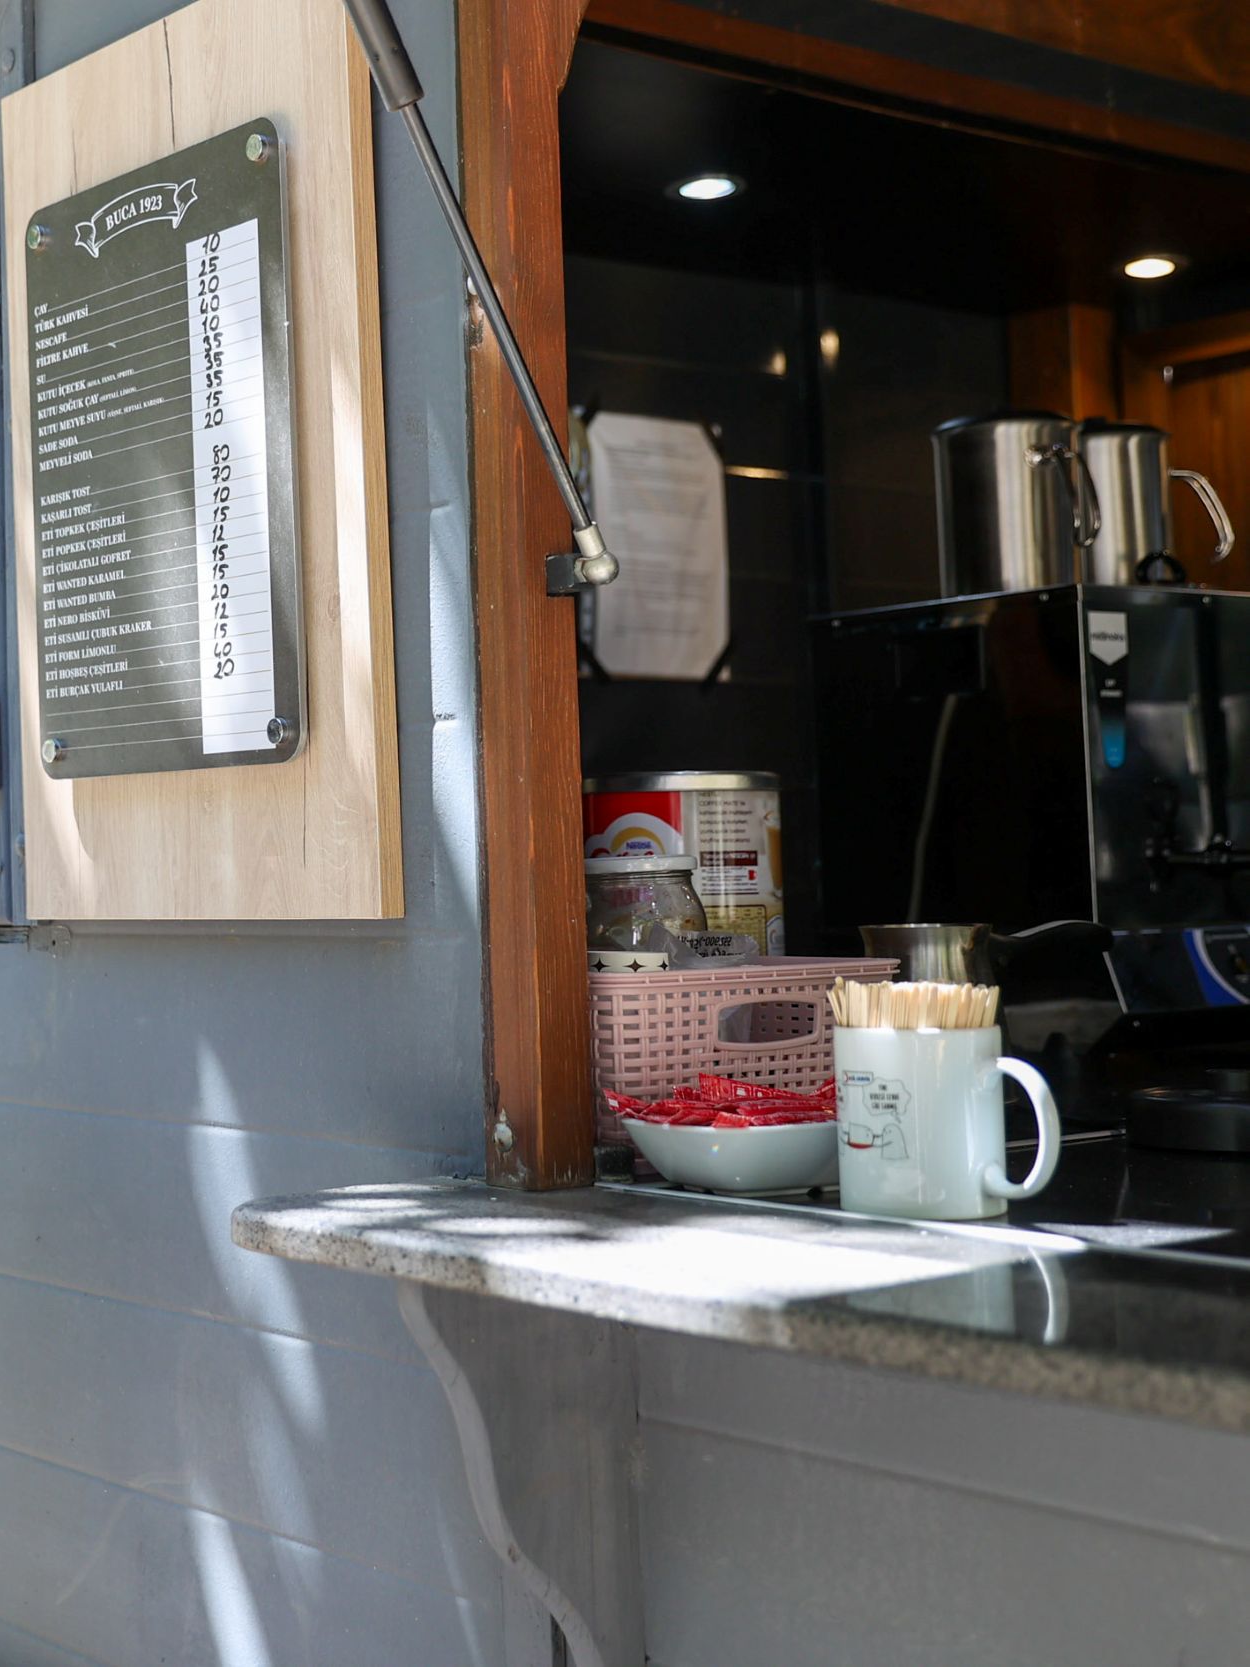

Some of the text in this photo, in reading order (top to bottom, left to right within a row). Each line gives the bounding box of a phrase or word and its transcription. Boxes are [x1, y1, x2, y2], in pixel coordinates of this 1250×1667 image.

[105, 195, 163, 231] BUCA 1923
[202, 232, 220, 253] 10
[198, 255, 220, 277] 25
[198, 274, 220, 296] 20
[34, 303, 48, 318] ÇAY
[200, 294, 220, 315] 40
[34, 304, 88, 333] TÜRK KAHVESİ
[202, 314, 220, 334] 10
[35, 331, 68, 351] NESCAFE
[203, 332, 224, 352] 35
[36, 342, 88, 368] FİLTRE KAHVE
[204, 351, 224, 370] 35
[36, 374, 46, 385] SU
[206, 369, 224, 388] 35
[37, 388, 58, 402] KUTU
[58, 380, 86, 397] İÇECEK
[206, 390, 223, 409] 15
[38, 405, 58, 420] KUTU
[59, 398, 84, 414] SOĞUK
[84, 393, 99, 408] ÇAY
[38, 423, 58, 437] KUTU
[60, 415, 86, 431] MEYVE
[86, 409, 106, 424] SUYU
[204, 408, 224, 429] 20
[38, 435, 78, 455] SADE SODA
[212, 444, 230, 464] 80
[39, 448, 93, 472] MEYVELİ SODA
[211, 465, 231, 484] 70
[40, 486, 90, 506] KARIŞIK TOST
[213, 486, 230, 504] 10
[40, 504, 92, 524] KAŞARLI TOST
[213, 506, 230, 522] 15
[42, 511, 125, 541] ETİ TOPKEK ÇEŞİTLERİ
[212, 524, 225, 542] 12
[42, 529, 126, 558] ETİ POPKEK ÇEŞİTLERİ
[212, 544, 228, 561] 15
[42, 550, 132, 576] ETİ ÇİKOLATALI GOFRET
[212, 563, 229, 580] 15
[43, 570, 124, 594] ETİ WANTED KARAMEL
[44, 590, 116, 611] ETİ WANTED BUMBA
[211, 584, 229, 601] 20
[44, 606, 110, 629] ETİ NERO BİSKÜVİ
[214, 602, 229, 620] 12
[44, 620, 152, 646] ETİ SUSAMLI ÇUBUK KRAKER
[214, 623, 228, 639] 15
[45, 644, 116, 664] ETİ FORM LİMONLU
[214, 642, 232, 659] 40
[46, 658, 128, 682] ETİ HOŞBEŞ ÇEŞİTLERİ
[214, 659, 234, 679] 20
[46, 680, 123, 699] ETİ BURÇAK YULAFLI
